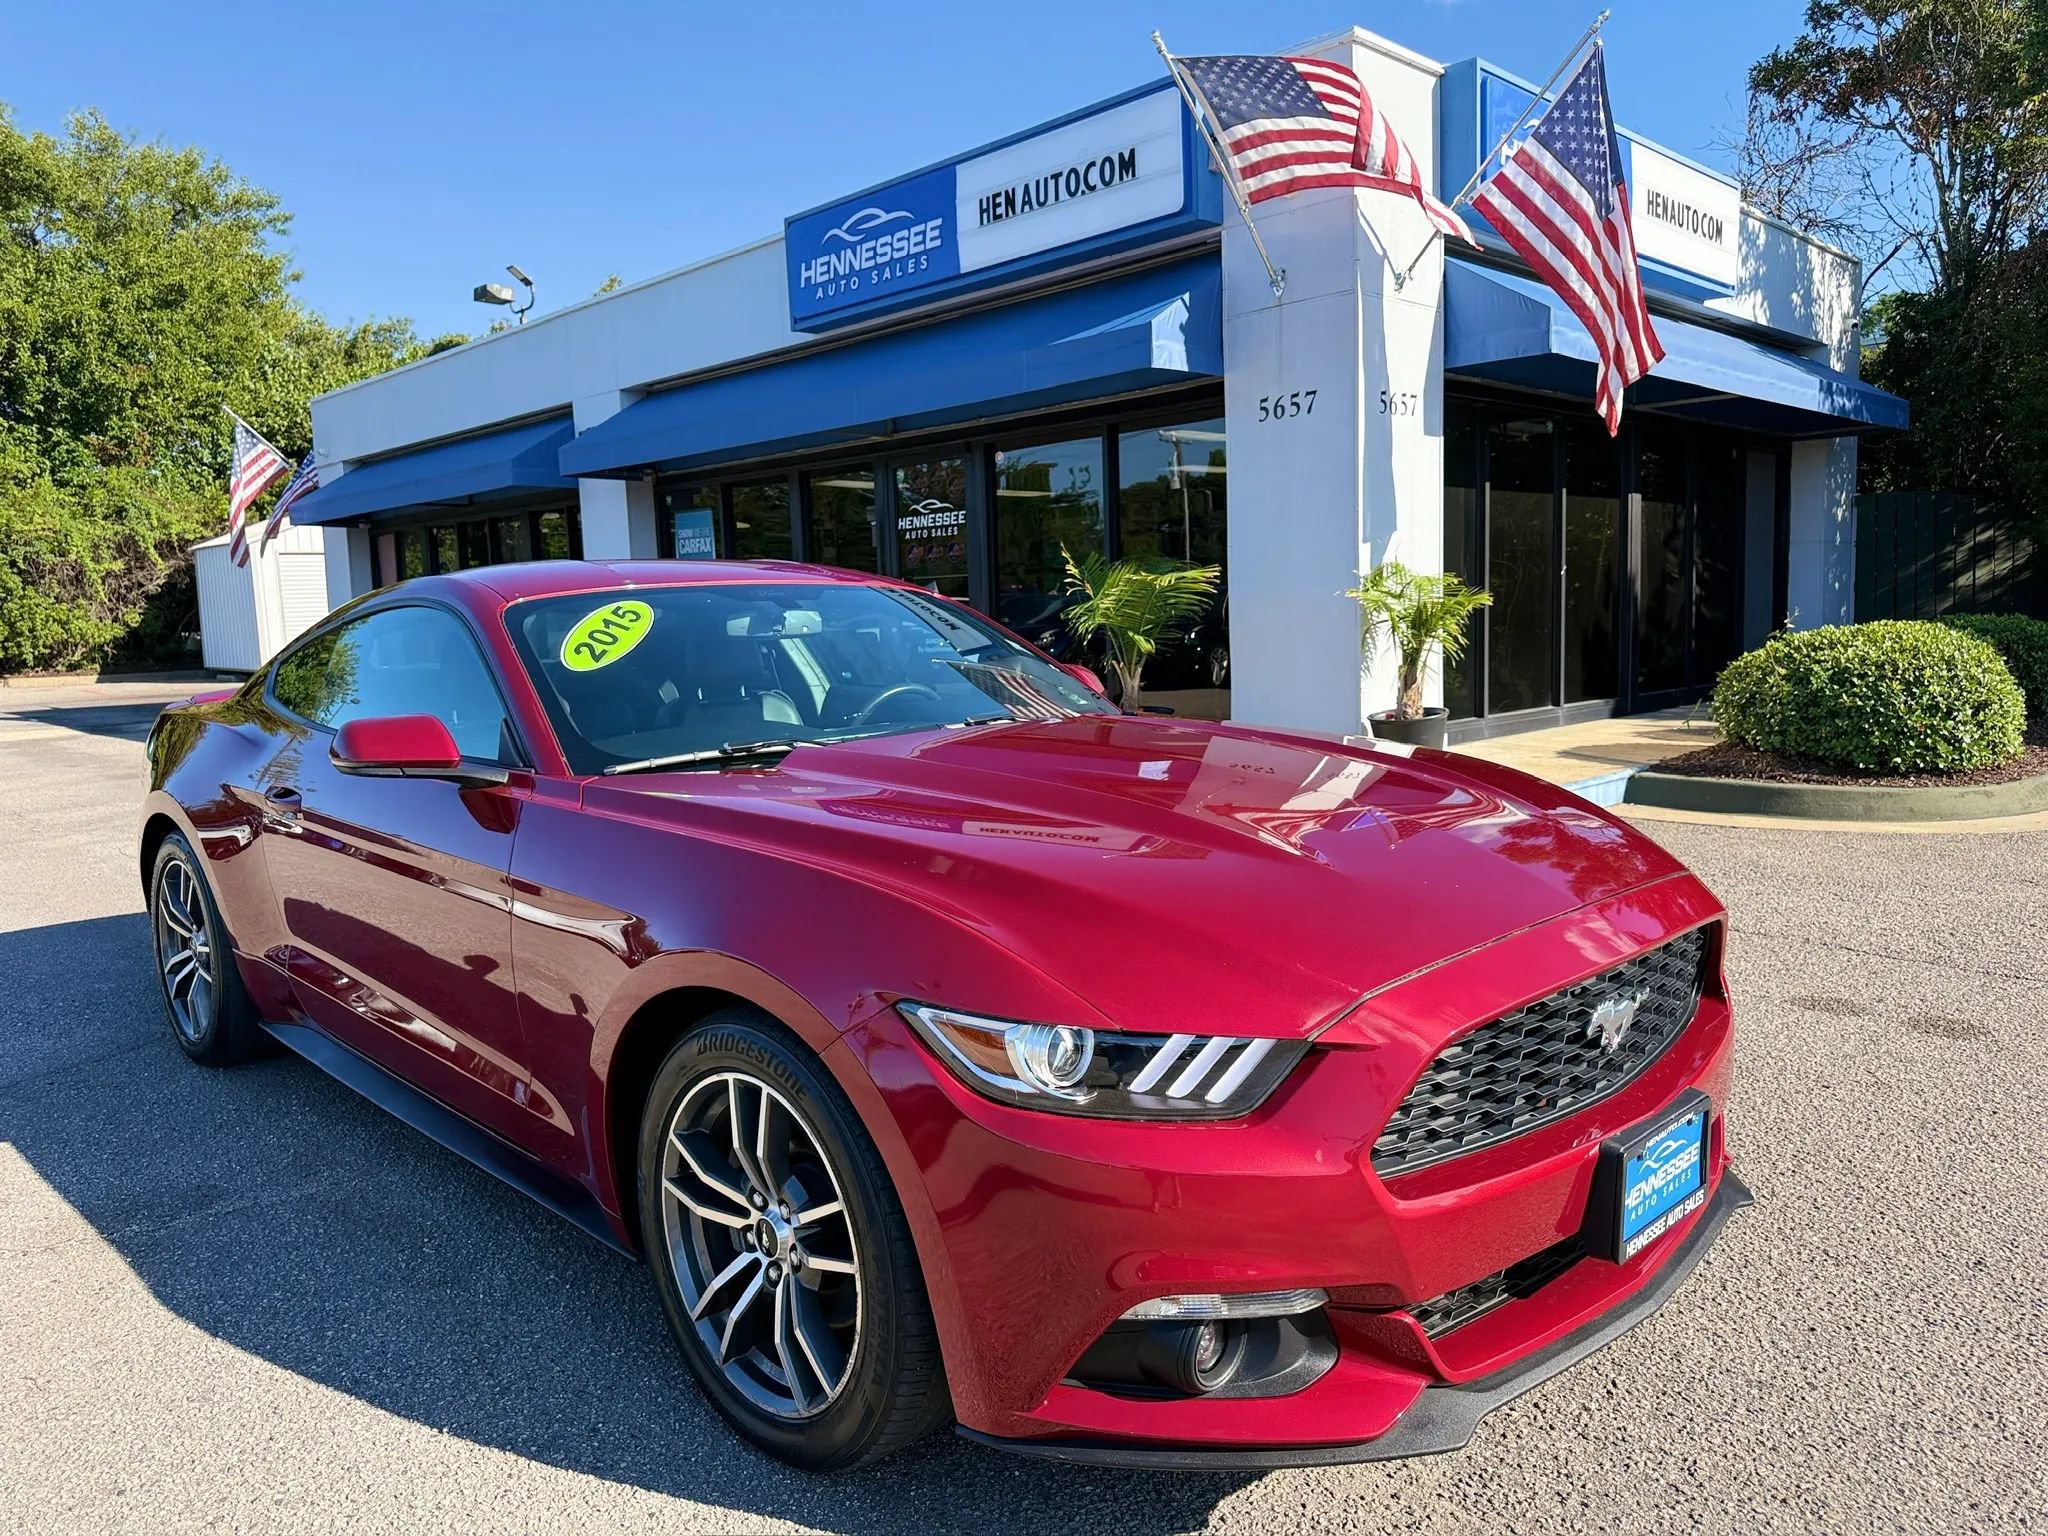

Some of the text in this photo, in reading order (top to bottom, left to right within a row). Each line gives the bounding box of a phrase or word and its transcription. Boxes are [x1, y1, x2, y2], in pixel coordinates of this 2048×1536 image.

[1647, 188, 1723, 245] HENAUTO.COM
[801, 217, 943, 288] HENNESSEE
[816, 255, 929, 300] AUTO SALES
[1258, 389, 1318, 422] 5657
[1379, 390, 1418, 416] 5657
[679, 537, 711, 554] CARFAX
[898, 510, 966, 529] HENNESSEE
[905, 526, 958, 540] AUTO SALES
[574, 605, 641, 663] 2015
[696, 1031, 808, 1101] BRIDGESTONE
[1625, 1140, 1700, 1210] HENNESSEE
[1630, 1168, 1692, 1222] AUTO SALES
[1626, 1188, 1705, 1259] HENNESSEE AUTO SALES
